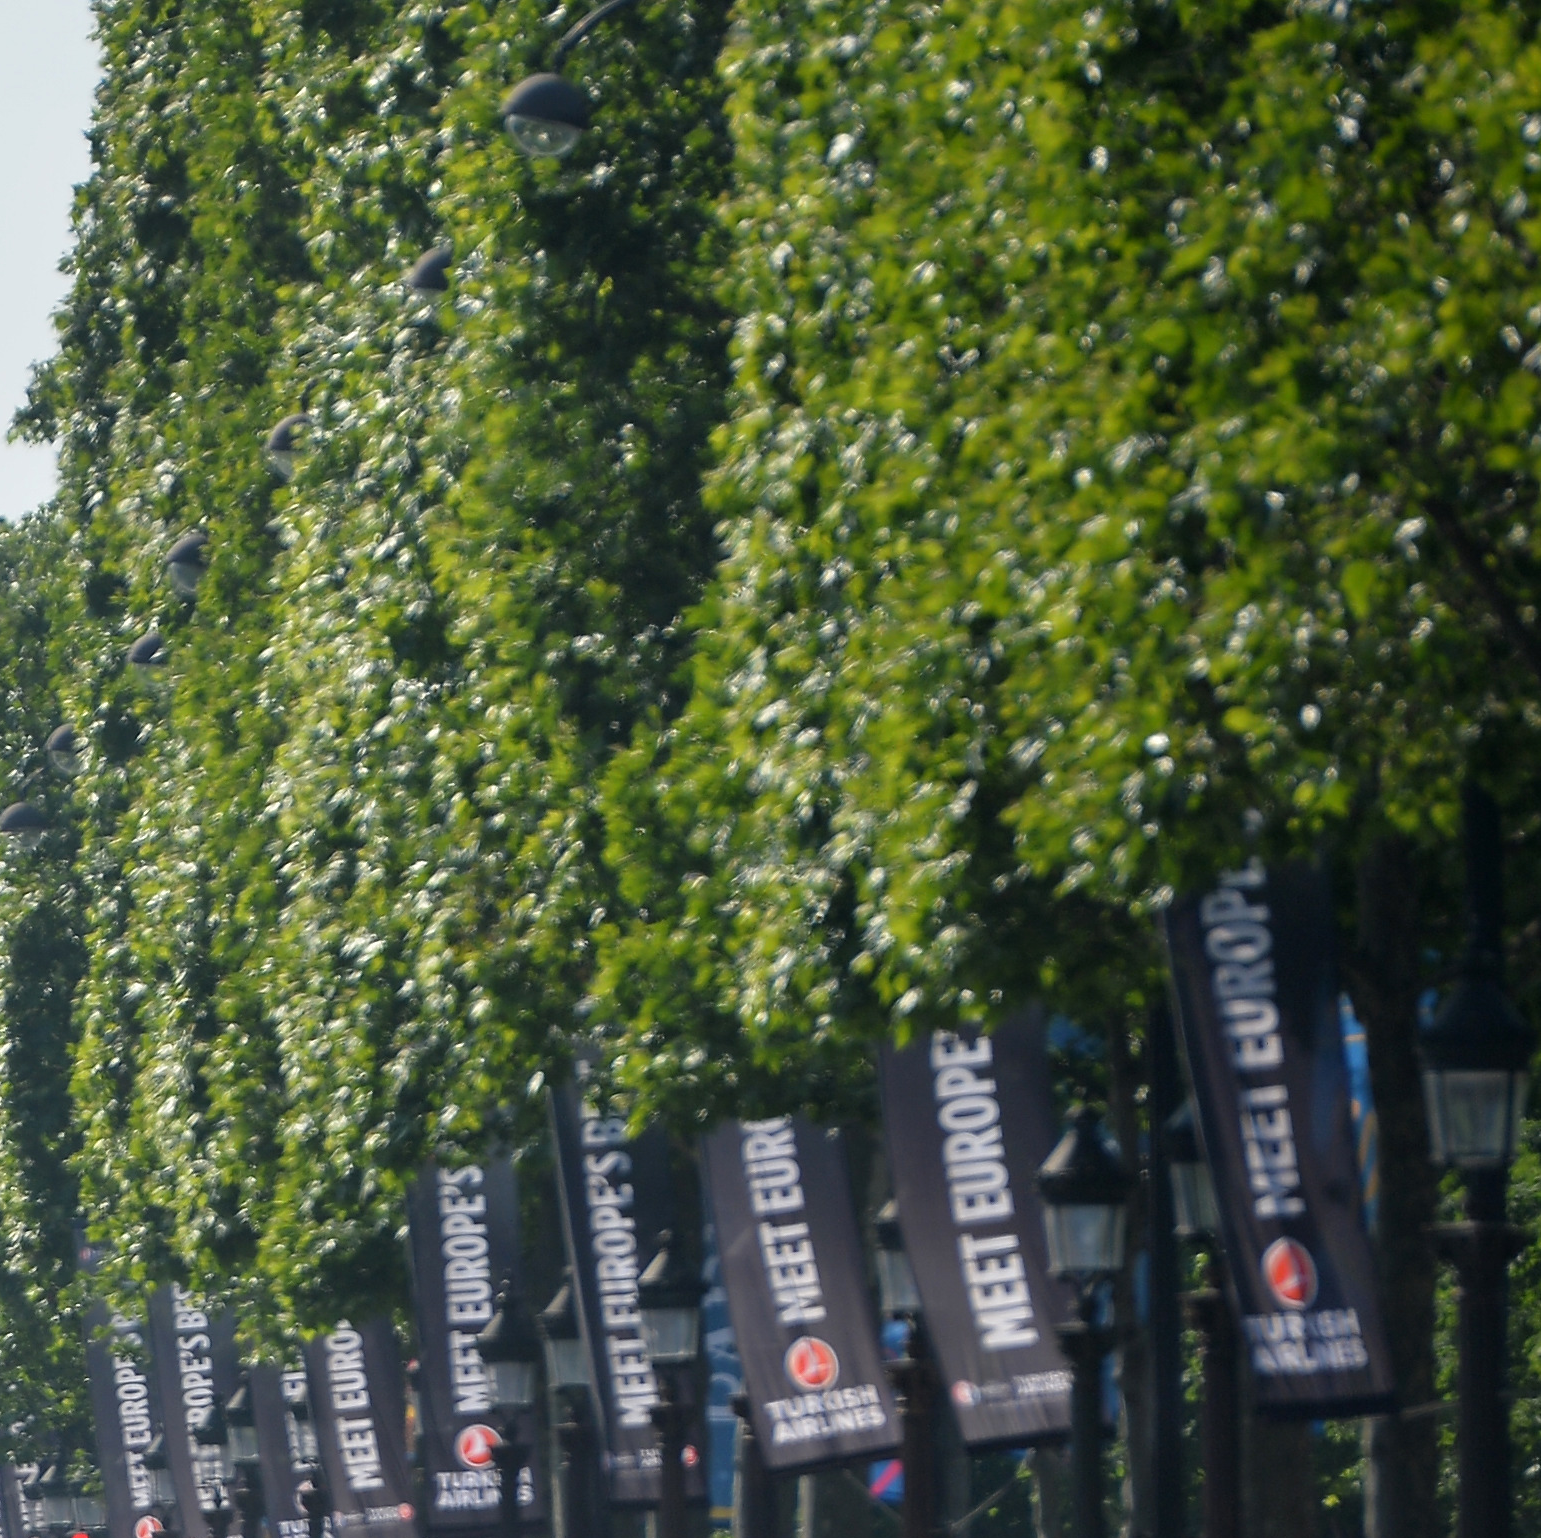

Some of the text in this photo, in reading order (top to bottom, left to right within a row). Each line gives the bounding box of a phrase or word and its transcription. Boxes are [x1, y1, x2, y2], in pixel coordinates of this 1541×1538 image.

[931, 1029, 1015, 1225] EUROPE
[1239, 1084, 1306, 1218] MEET
[438, 1163, 493, 1325] EUROPE'S
[584, 1150, 643, 1329] EUROPE'S
[759, 1222, 827, 1325] MEET
[958, 1233, 1040, 1351] MEET
[605, 1334, 660, 1428] MEET
[764, 1384, 879, 1419] TURKISH
[772, 1404, 887, 1445] AIRLINES
[335, 1418, 385, 1490] MEET
